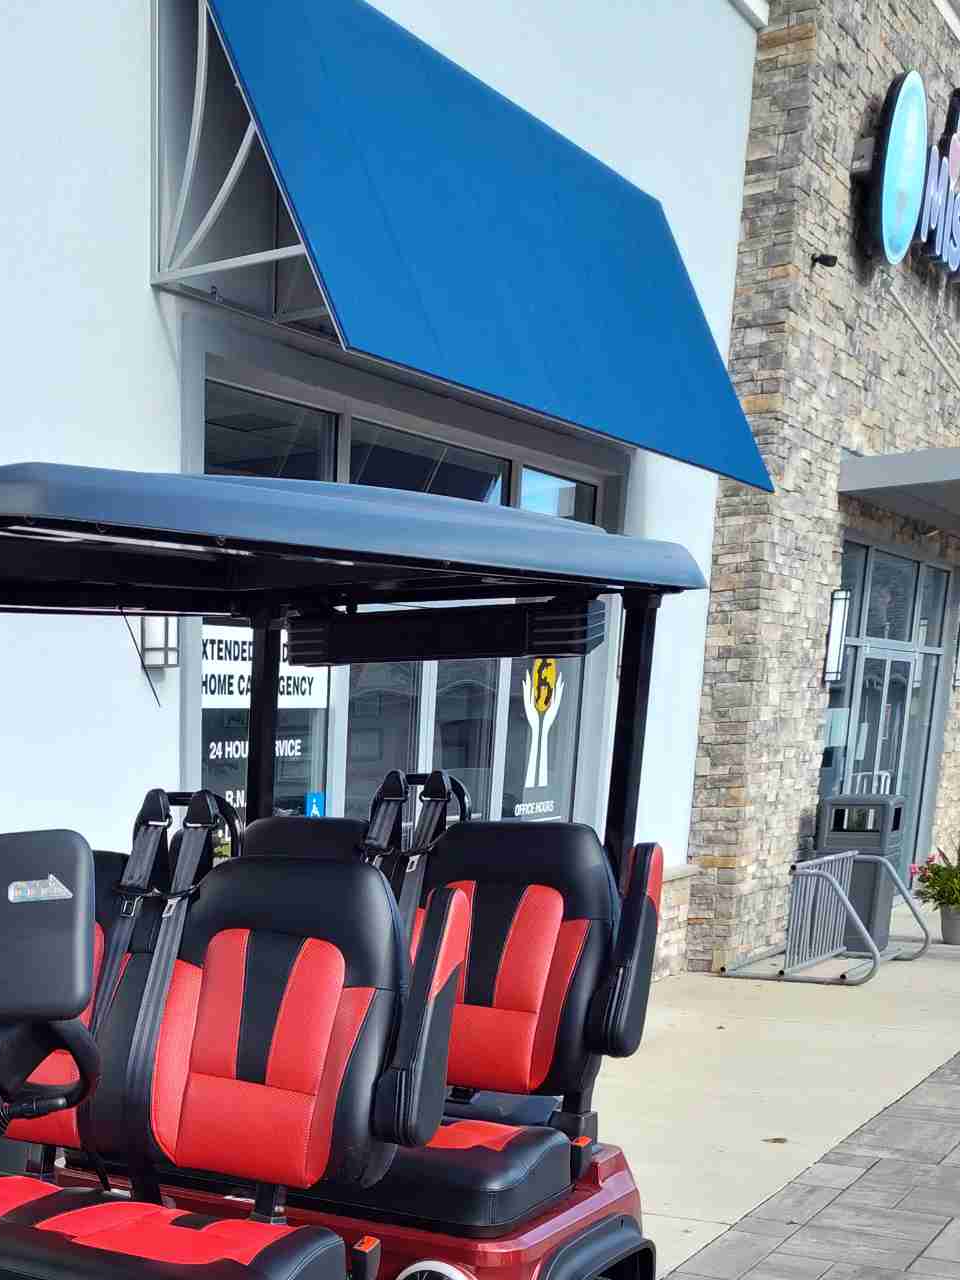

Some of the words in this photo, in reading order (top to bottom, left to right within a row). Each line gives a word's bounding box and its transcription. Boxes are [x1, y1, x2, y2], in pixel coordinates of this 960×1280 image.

[202, 674, 234, 695] HOME
[279, 675, 314, 696] GENCY
[209, 742, 222, 759] 24
[225, 740, 249, 758] HOU
[514, 803, 536, 817] OFFICE
[536, 800, 554, 814] HOURS
